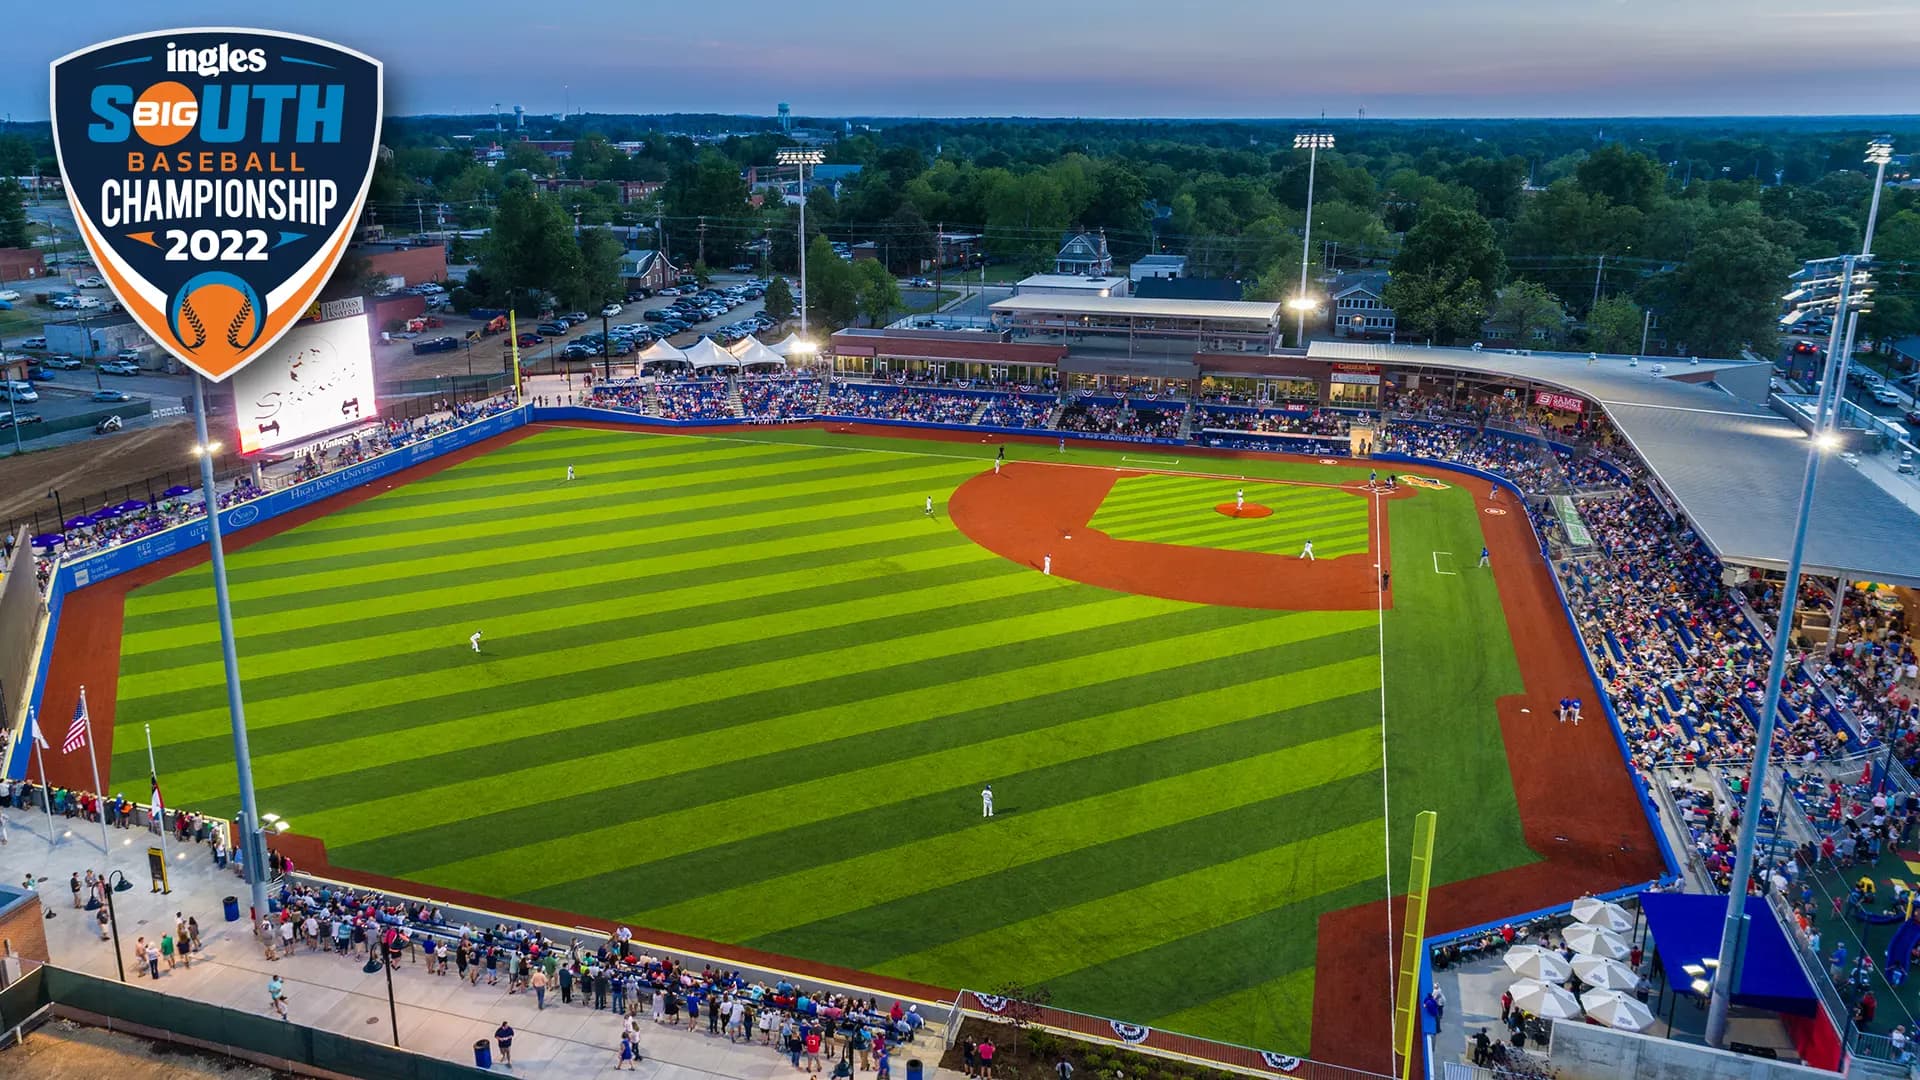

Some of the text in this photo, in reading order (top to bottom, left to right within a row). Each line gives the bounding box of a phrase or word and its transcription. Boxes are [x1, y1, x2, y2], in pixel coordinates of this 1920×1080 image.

[1553, 395, 1583, 409] SAMET
[294, 428, 376, 460] HPU Vintage Seats
[290, 461, 386, 500] HIGH POINT UNIVERSITY
